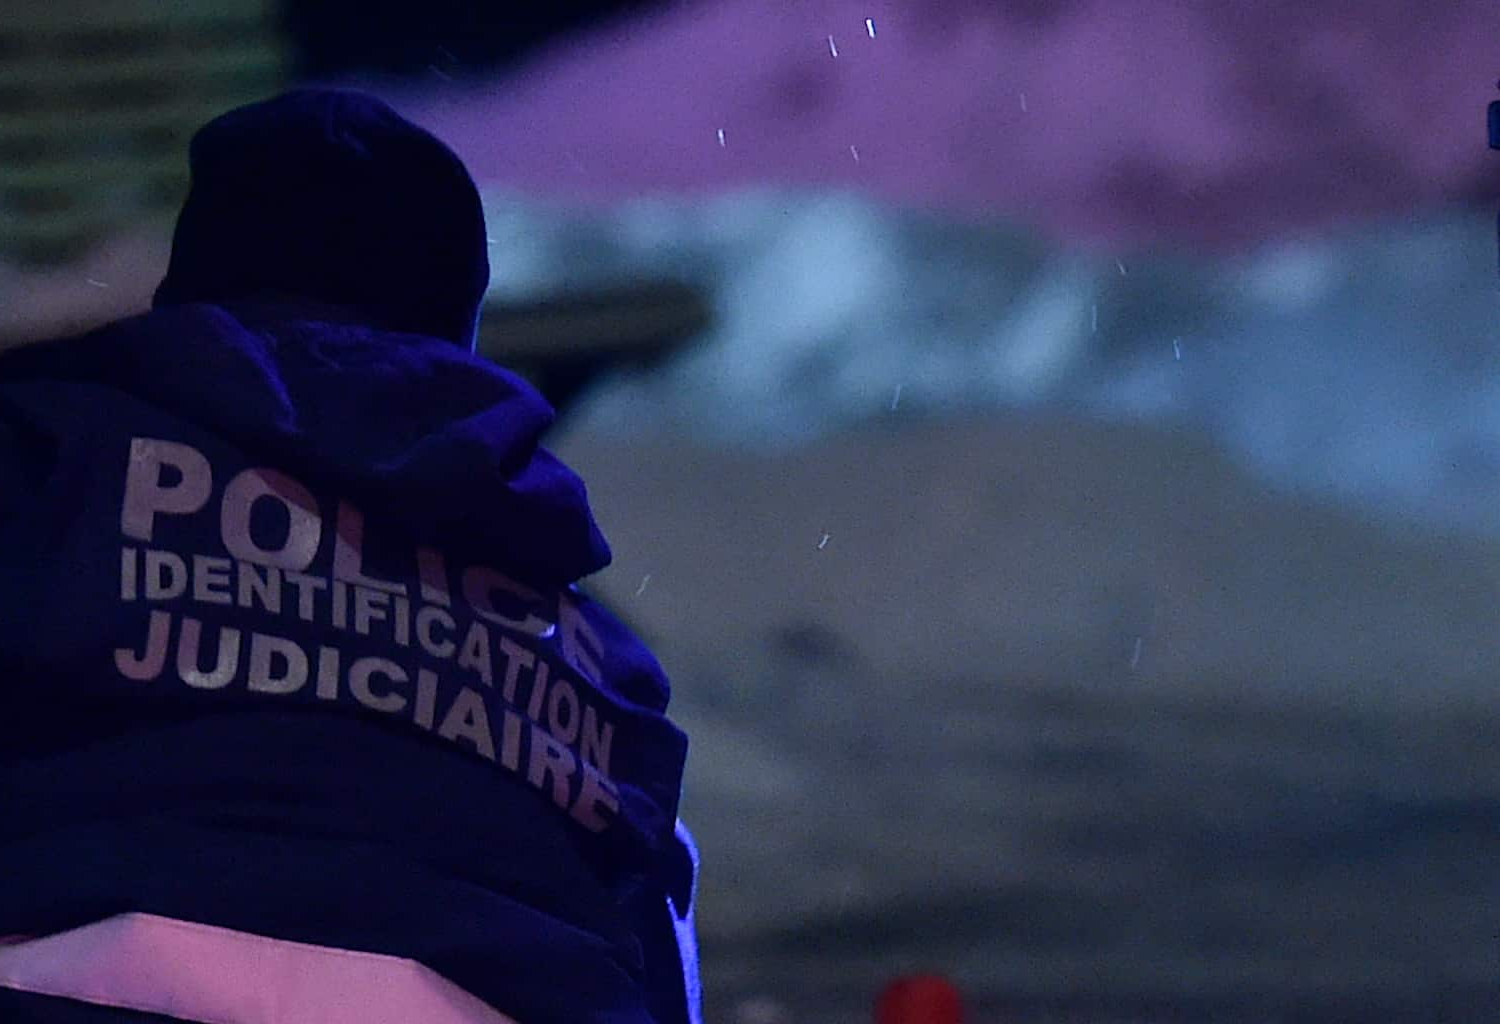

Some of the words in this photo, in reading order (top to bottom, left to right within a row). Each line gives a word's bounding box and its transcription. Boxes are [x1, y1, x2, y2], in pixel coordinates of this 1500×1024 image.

[120, 436, 606, 689] POLICE
[120, 546, 615, 780] IDENTIFICATION
[113, 608, 620, 834] JUDICIAIRE
